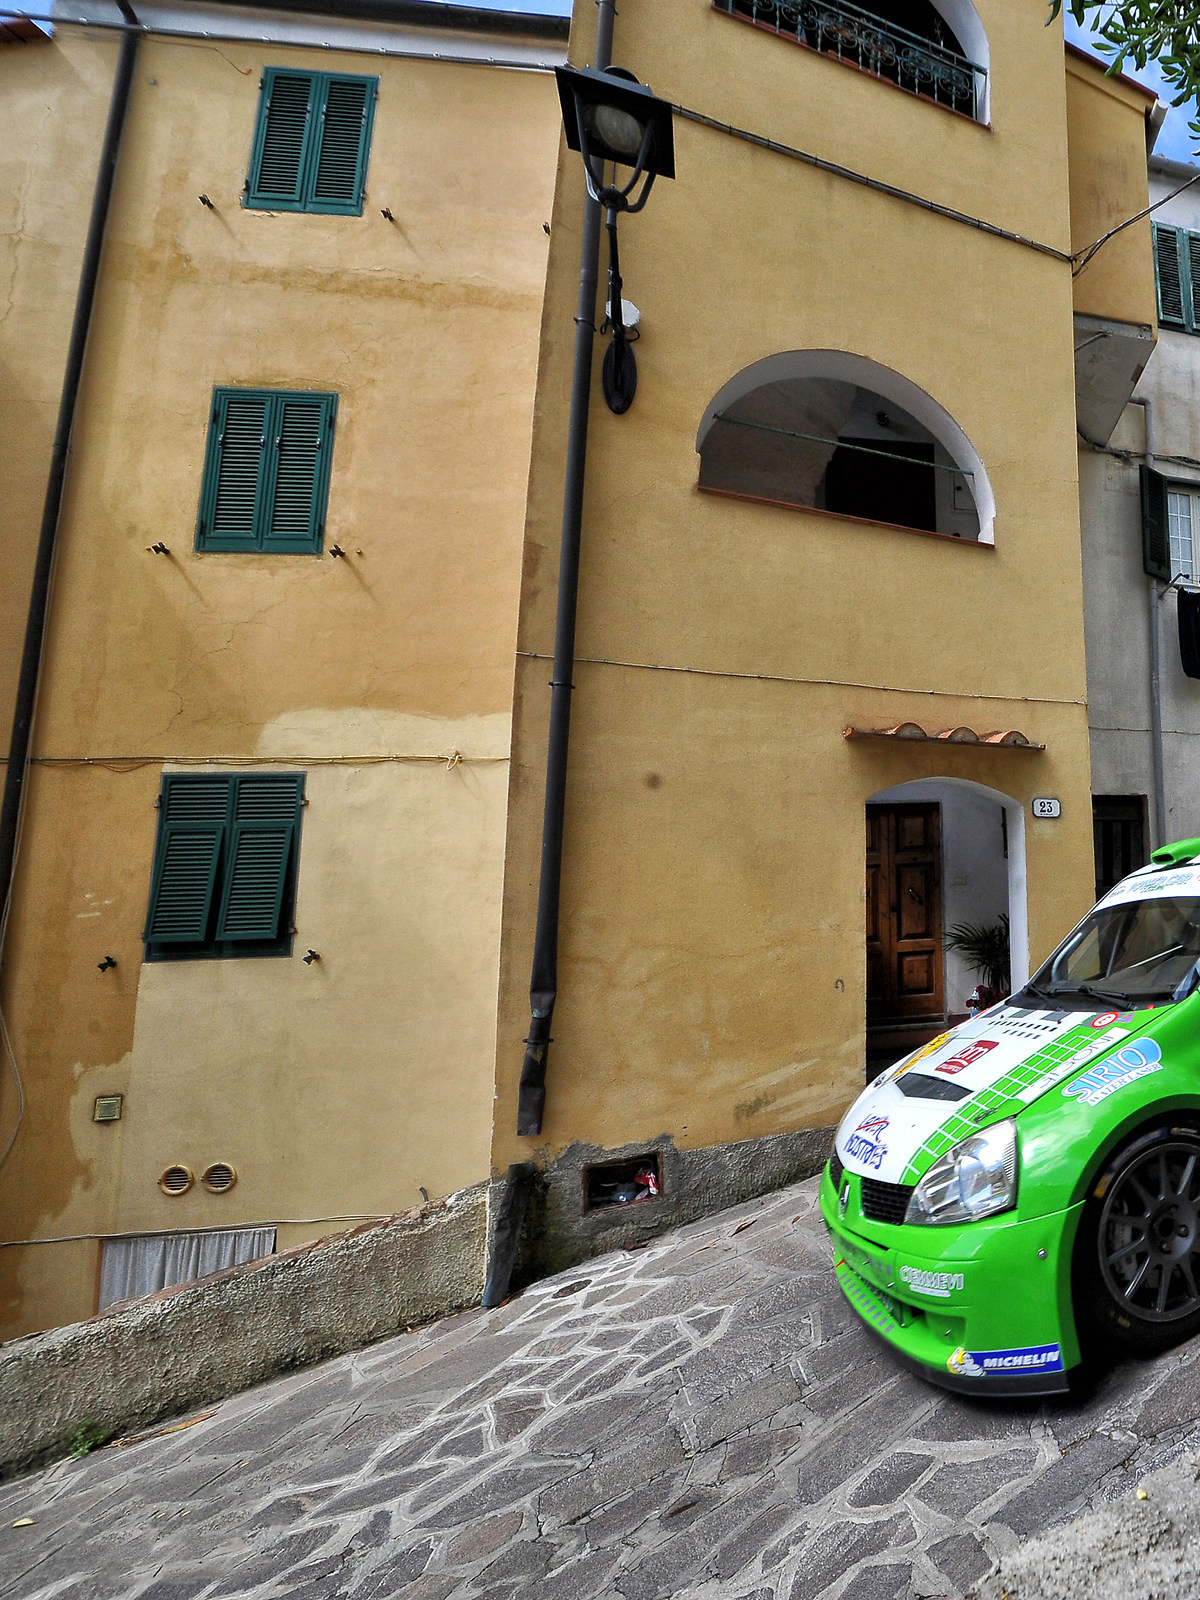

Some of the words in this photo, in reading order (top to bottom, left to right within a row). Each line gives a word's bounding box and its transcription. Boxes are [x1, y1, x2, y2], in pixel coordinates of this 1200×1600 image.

[1039, 800, 1054, 813] 23
[1061, 1046, 1149, 1103] SIRIO
[1089, 1078, 1127, 1103] WATER
[1127, 1064, 1162, 1081] LASER
[983, 1350, 1060, 1369] MICHELIN
